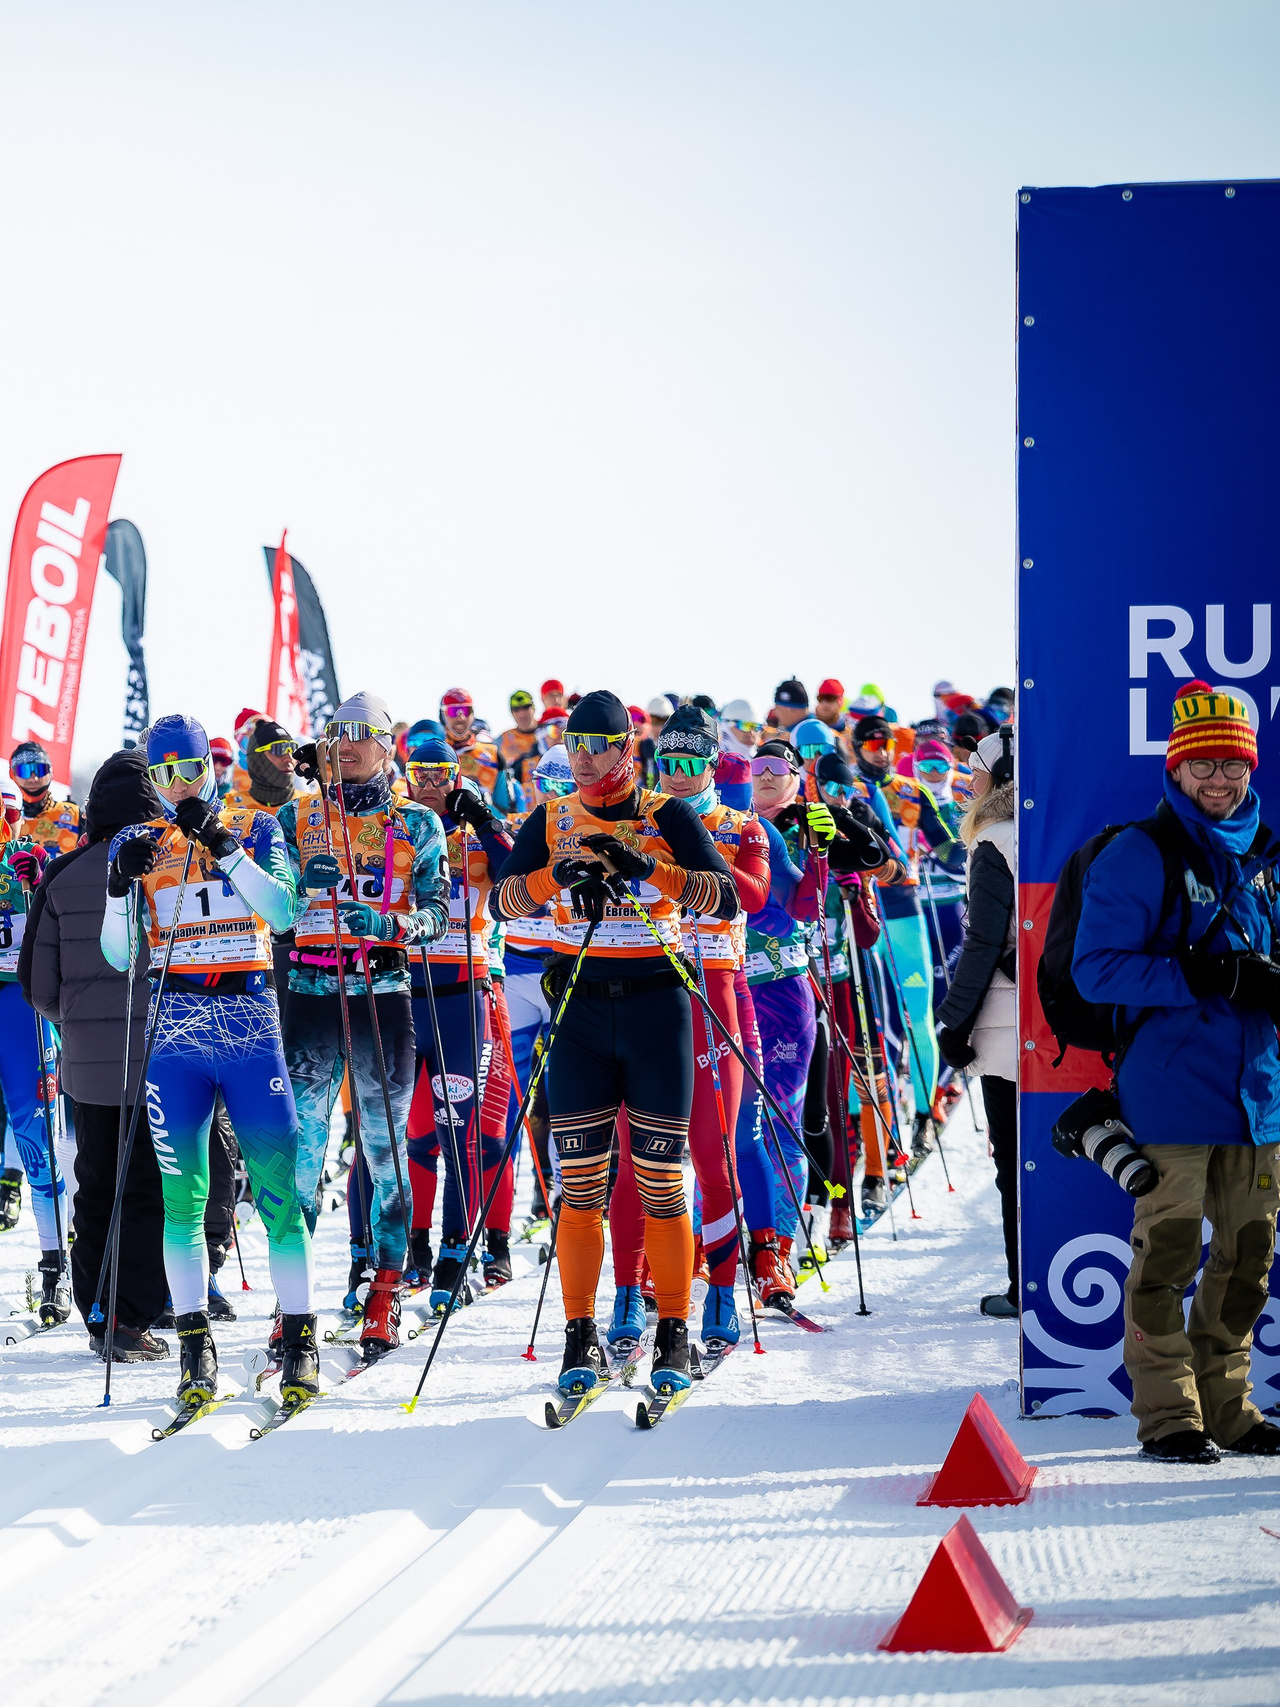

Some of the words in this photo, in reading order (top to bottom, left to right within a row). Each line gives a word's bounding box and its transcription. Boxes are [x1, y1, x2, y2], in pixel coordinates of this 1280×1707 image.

[11, 497, 91, 744] TEBOIL
[270, 846, 290, 880] ОМИ
[195, 887, 210, 917] 1
[435, 1077, 469, 1088] DMINO
[479, 1043, 492, 1102] SATURN
